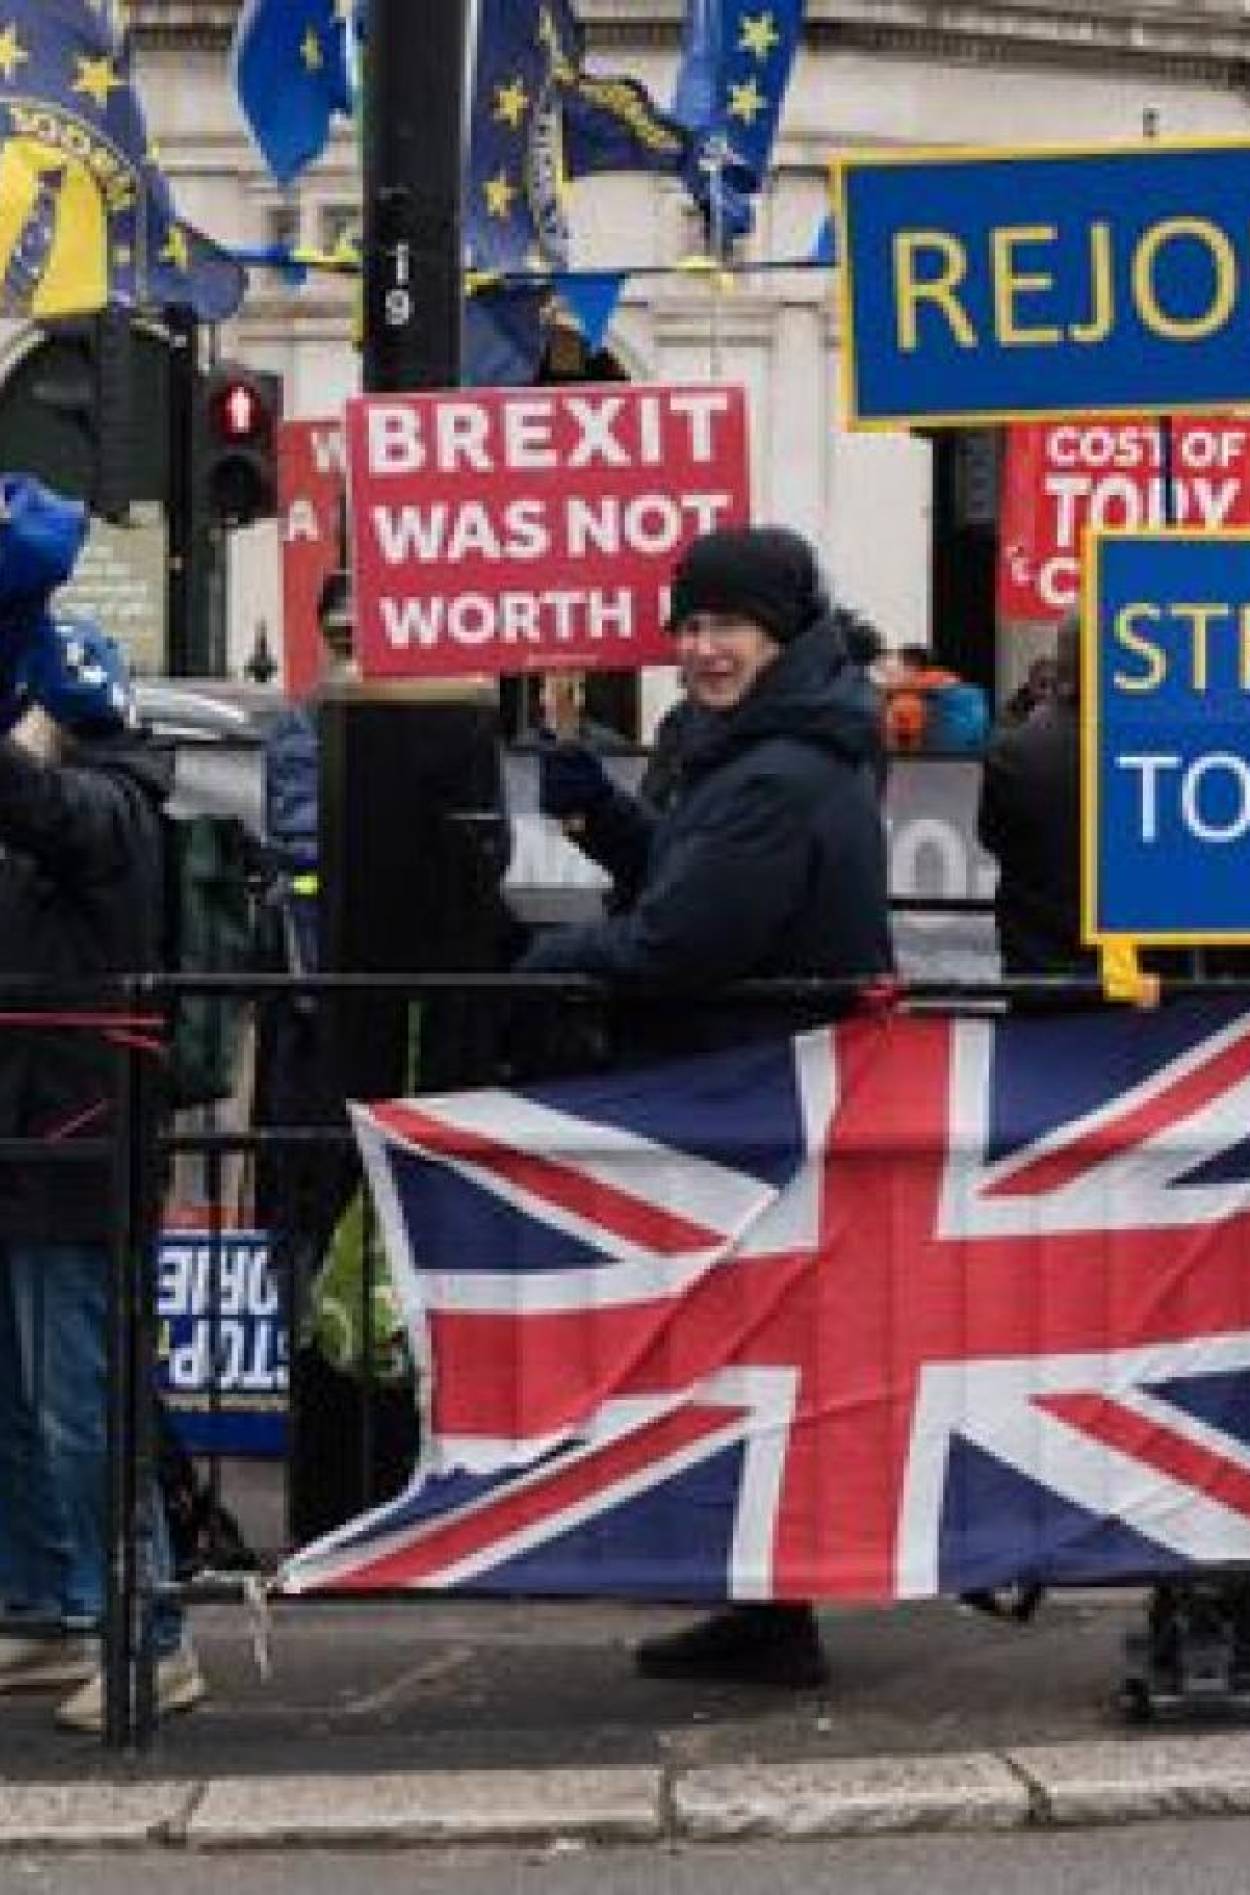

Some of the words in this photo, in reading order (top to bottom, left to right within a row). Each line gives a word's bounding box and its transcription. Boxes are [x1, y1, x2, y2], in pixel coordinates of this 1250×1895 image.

[368, 394, 728, 473] BREXIT
[1046, 427, 1161, 467] COST
[1179, 431, 1247, 468] OF
[372, 500, 551, 563] WAS
[566, 494, 733, 556] NOT
[378, 590, 632, 648] WORTH
